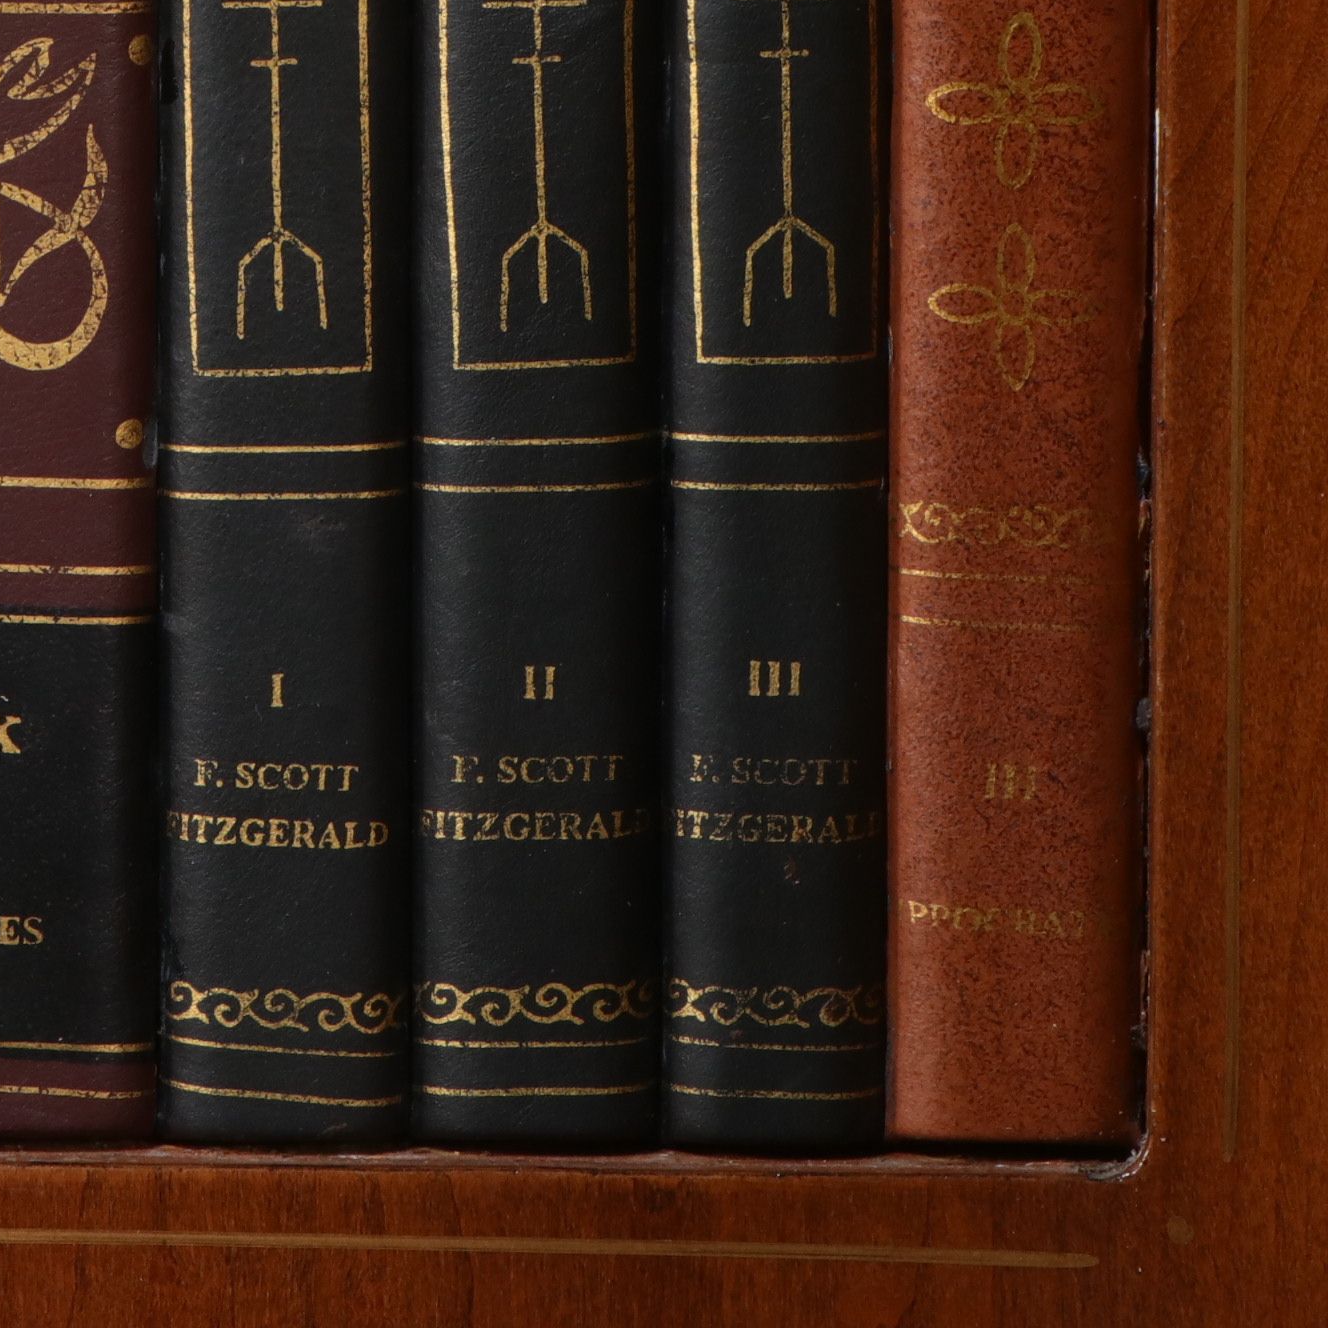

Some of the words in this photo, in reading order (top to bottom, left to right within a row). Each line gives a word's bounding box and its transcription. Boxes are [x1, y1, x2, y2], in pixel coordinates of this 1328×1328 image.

[271, 673, 284, 707] I
[523, 666, 556, 699] II
[748, 660, 801, 696] III
[193, 759, 224, 788] F.
[235, 762, 359, 791] SCOTT
[450, 755, 483, 783] F.
[496, 755, 623, 783] SCOTT
[732, 757, 857, 785] SCOTT
[984, 763, 1035, 800] III
